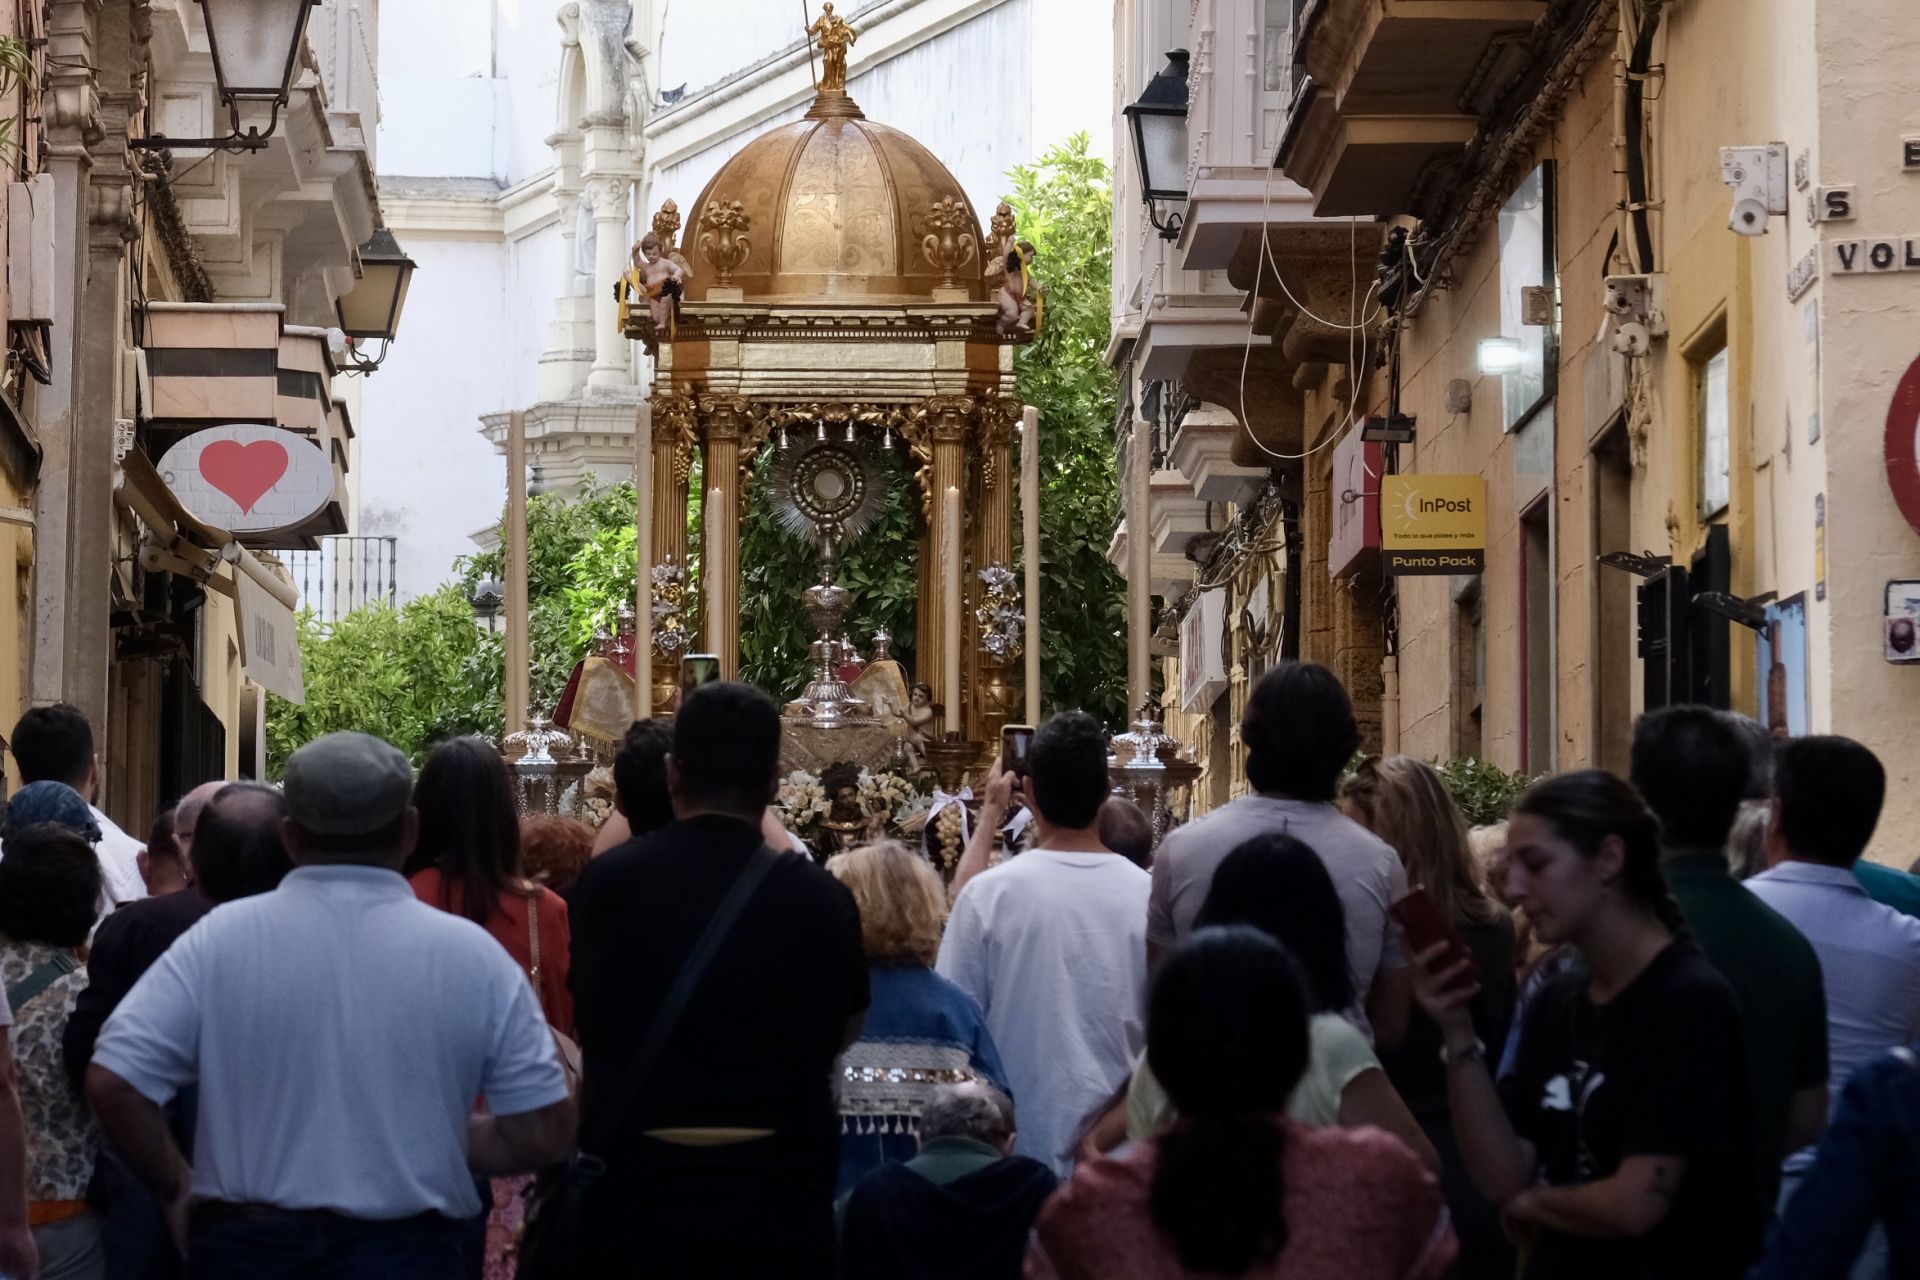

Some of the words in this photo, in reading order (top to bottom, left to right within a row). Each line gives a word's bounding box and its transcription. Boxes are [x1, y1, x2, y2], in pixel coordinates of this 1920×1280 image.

[1826, 191, 1850, 218] S
[1420, 498, 1472, 513] InPost
[1392, 556, 1436, 567] Punto
[1439, 556, 1476, 566] Pack
